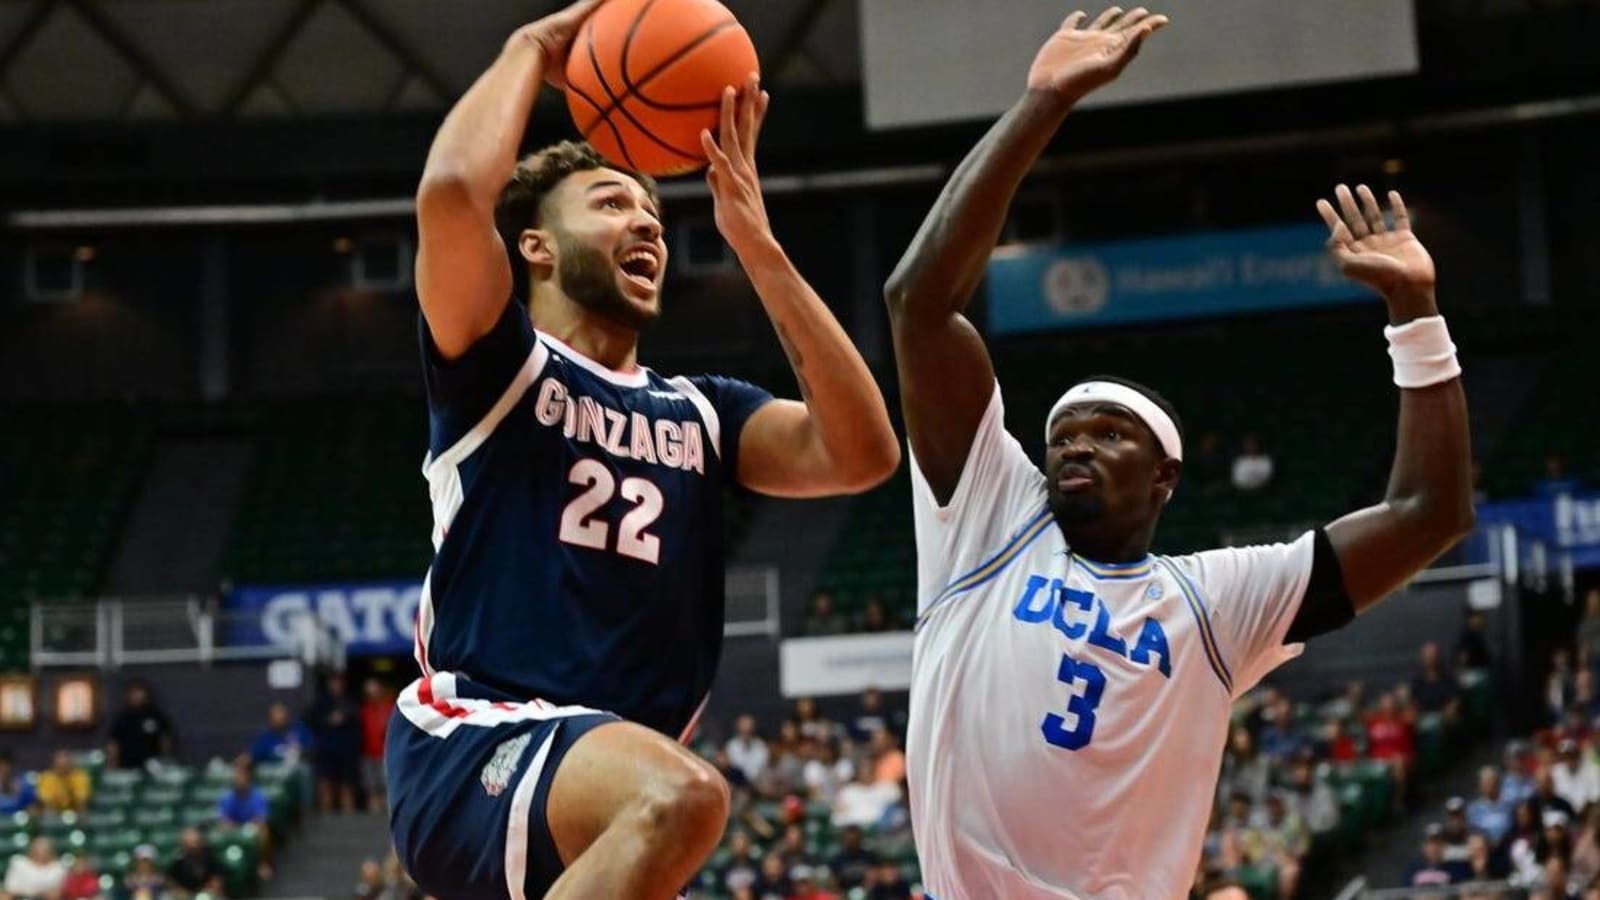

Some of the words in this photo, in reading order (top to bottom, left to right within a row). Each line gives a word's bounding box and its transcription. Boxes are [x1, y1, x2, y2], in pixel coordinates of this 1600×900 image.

[534, 376, 705, 476] GONZAGA
[558, 457, 664, 566] 22
[1013, 574, 1172, 679] UCLA
[1041, 652, 1107, 751] 3
